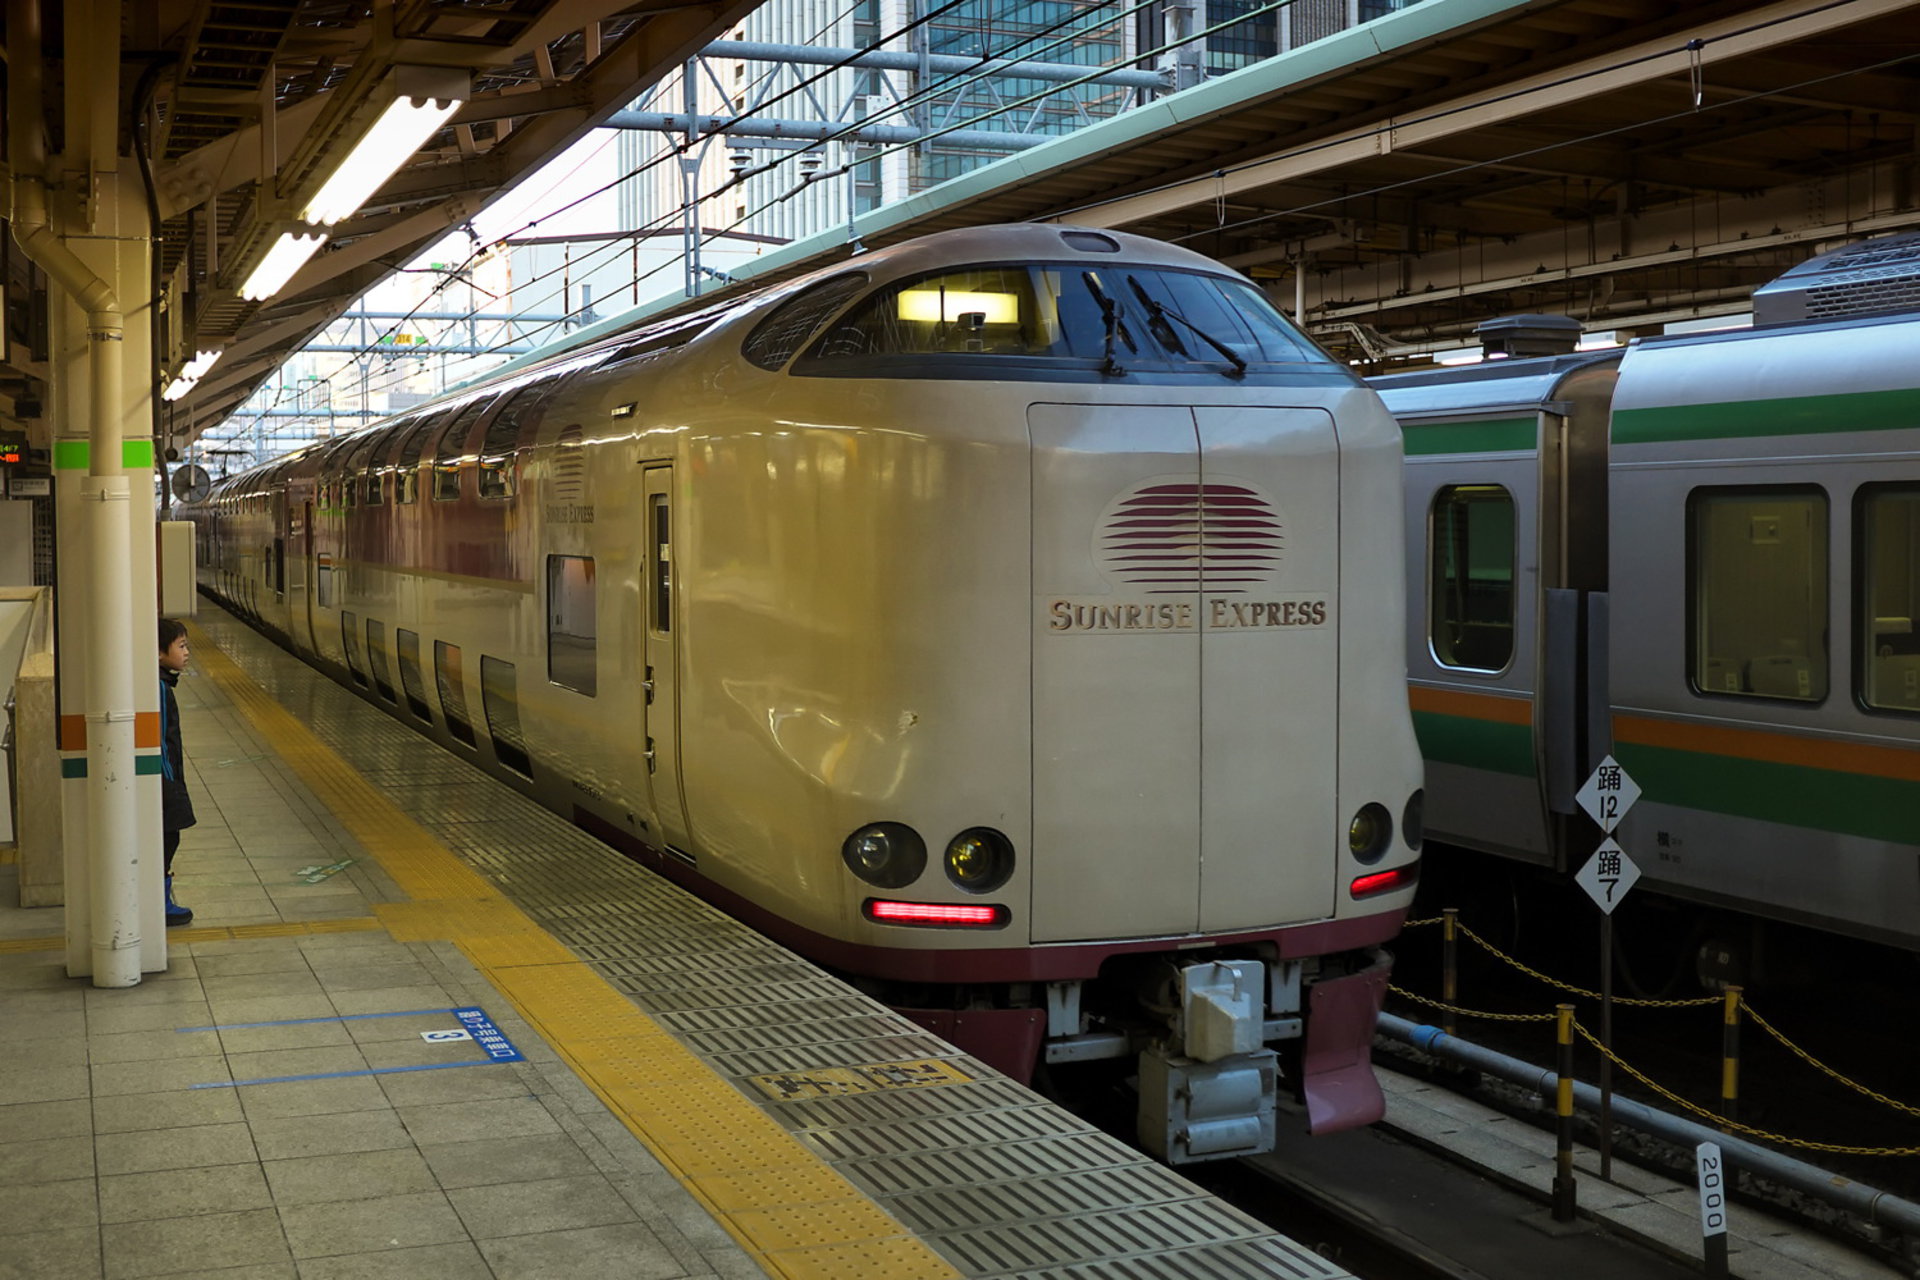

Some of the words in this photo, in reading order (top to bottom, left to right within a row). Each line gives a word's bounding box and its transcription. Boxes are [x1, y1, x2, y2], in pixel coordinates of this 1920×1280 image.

[1049, 599, 1193, 631] SUNRISE
[1209, 599, 1327, 628] EXPRESS
[1597, 765, 1621, 791] 踊
[1600, 796, 1618, 819] 12
[1597, 850, 1621, 876] 踊
[1598, 878, 1619, 902] 7
[427, 1031, 464, 1040] 3
[1702, 1156, 1723, 1229] 2000
